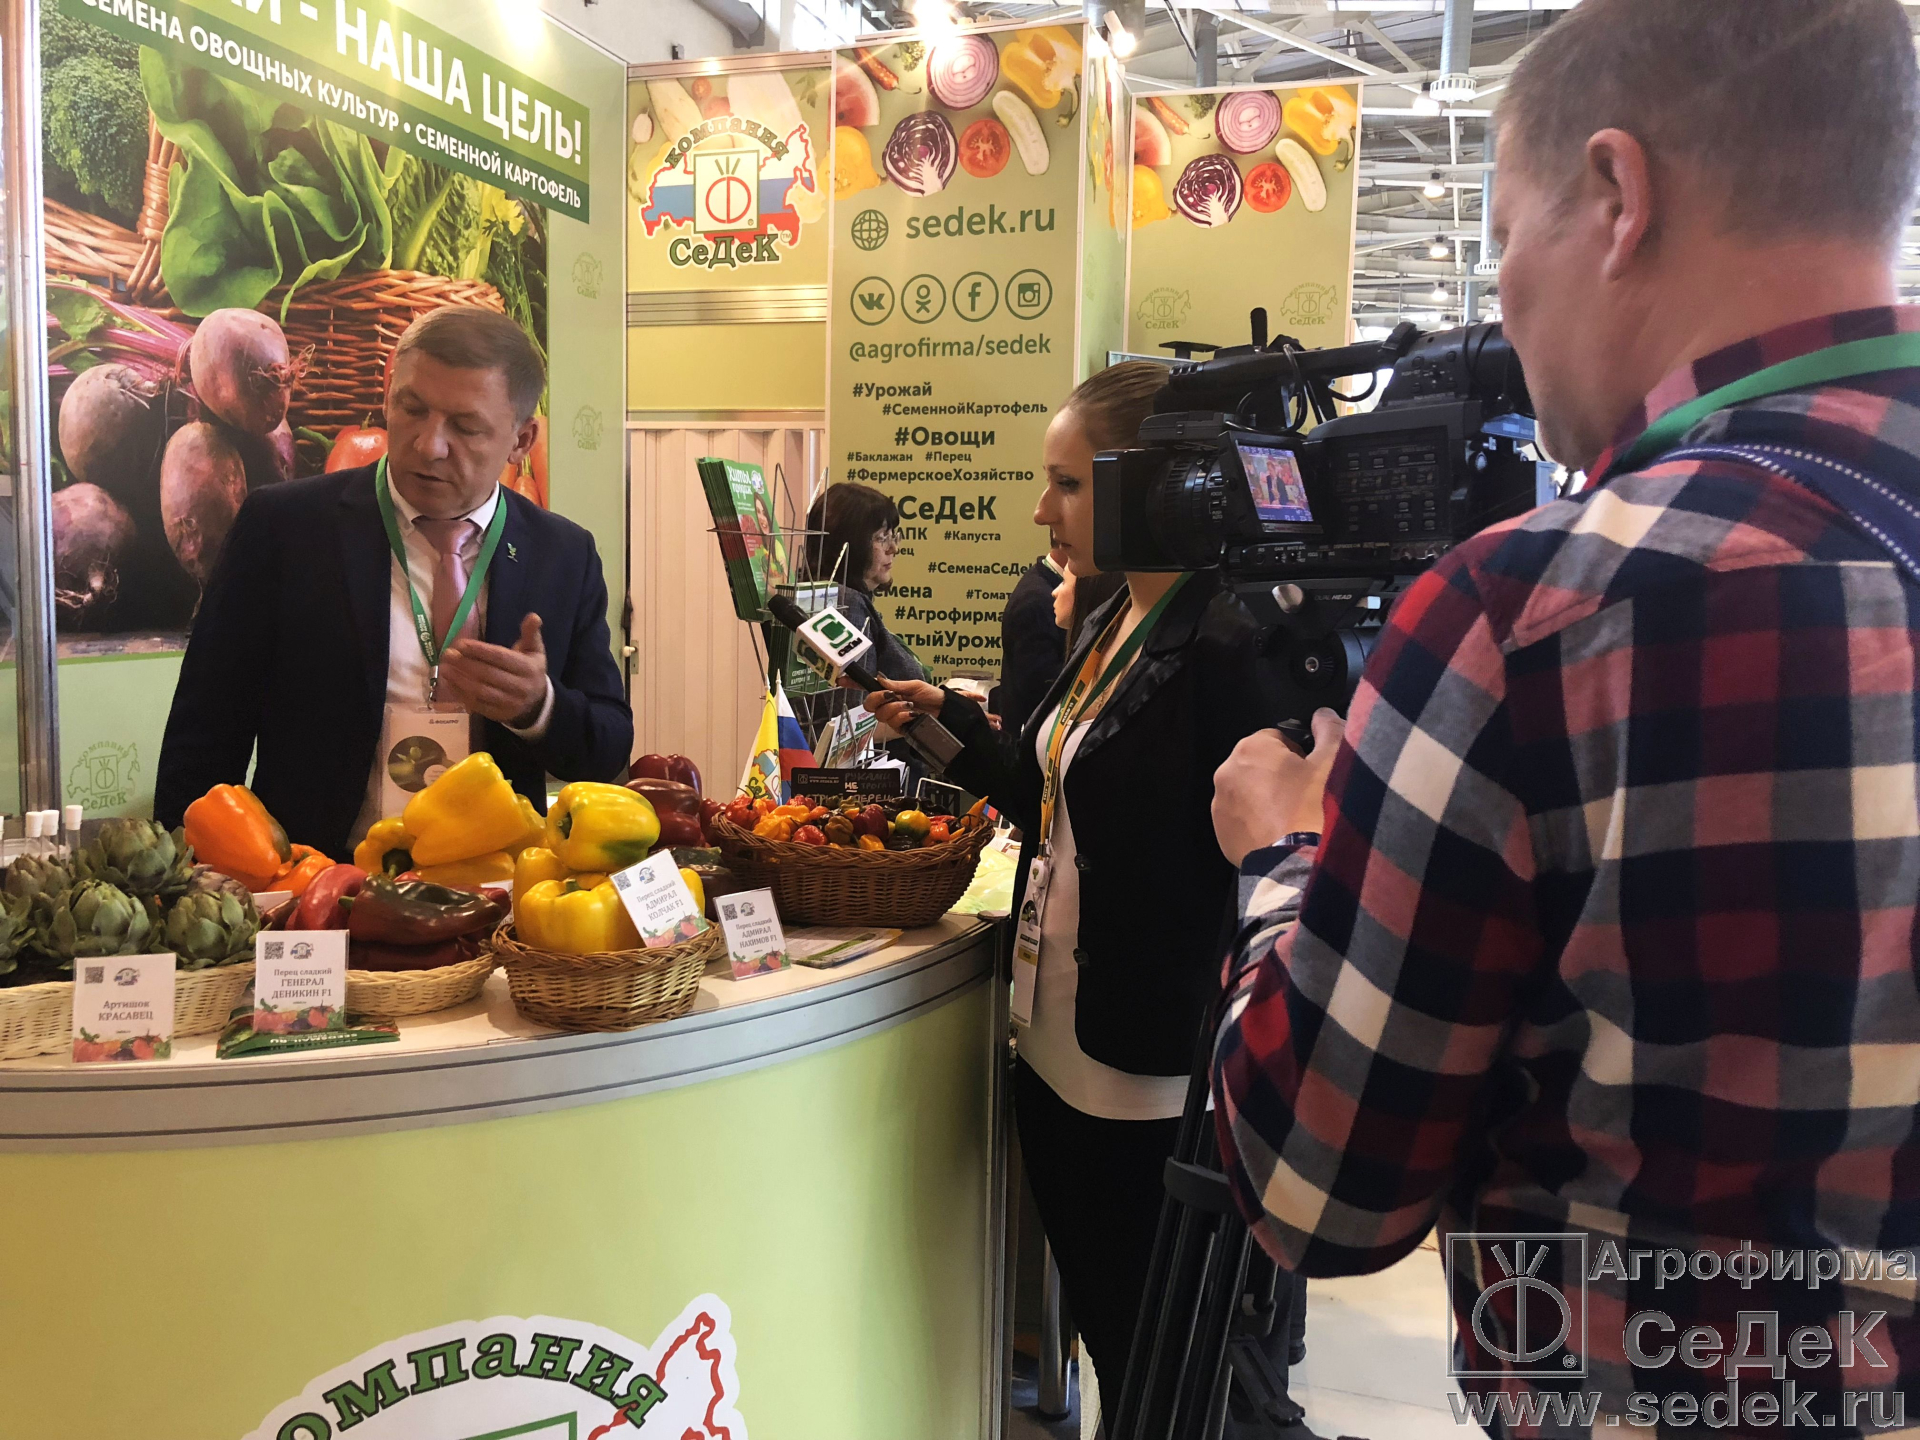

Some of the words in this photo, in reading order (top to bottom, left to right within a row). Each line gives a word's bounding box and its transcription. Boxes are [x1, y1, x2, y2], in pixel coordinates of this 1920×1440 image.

[335, 0, 472, 114] НАША
[483, 72, 582, 165] ЦЕЛЬ!
[190, 26, 313, 98] ОВОЩНЫХ
[318, 79, 399, 131] КУЛЬТУР
[416, 124, 501, 176] СЕМЕННОЙ
[504, 160, 581, 208] КАРТОФЕЛЬ
[906, 204, 1055, 239] sedek.ru
[849, 333, 1051, 363] @agrofirma/sedek
[853, 382, 932, 400] #Урожай
[882, 402, 1048, 417] #СеменнойКартофель
[894, 426, 996, 448] #Овощи
[847, 452, 913, 463] #Баклажан
[925, 452, 972, 464] #Перец
[847, 468, 1034, 484] #ФермерскоеХозяйство
[889, 495, 997, 524] СеДеК
[944, 531, 1001, 543] #Капуста
[928, 562, 1033, 576] #СеменаСеДе
[845, 782, 858, 790] НЕ
[645, 890, 678, 911] АДМИРАЛ
[648, 903, 676, 921] КОЛЧАК
[675, 899, 684, 908] F1
[742, 926, 772, 938] АДМИРАЛ
[739, 936, 770, 948] НАХИМОВ
[274, 968, 298, 977] Перец
[300, 968, 332, 976] сладкий
[281, 978, 324, 987] ГЕНЕРАЛ
[272, 989, 319, 999] ДЕНИКИН
[321, 989, 332, 997] F1
[103, 1000, 150, 1011] Артишок
[98, 1011, 154, 1021] КРАСАВЕЦ
